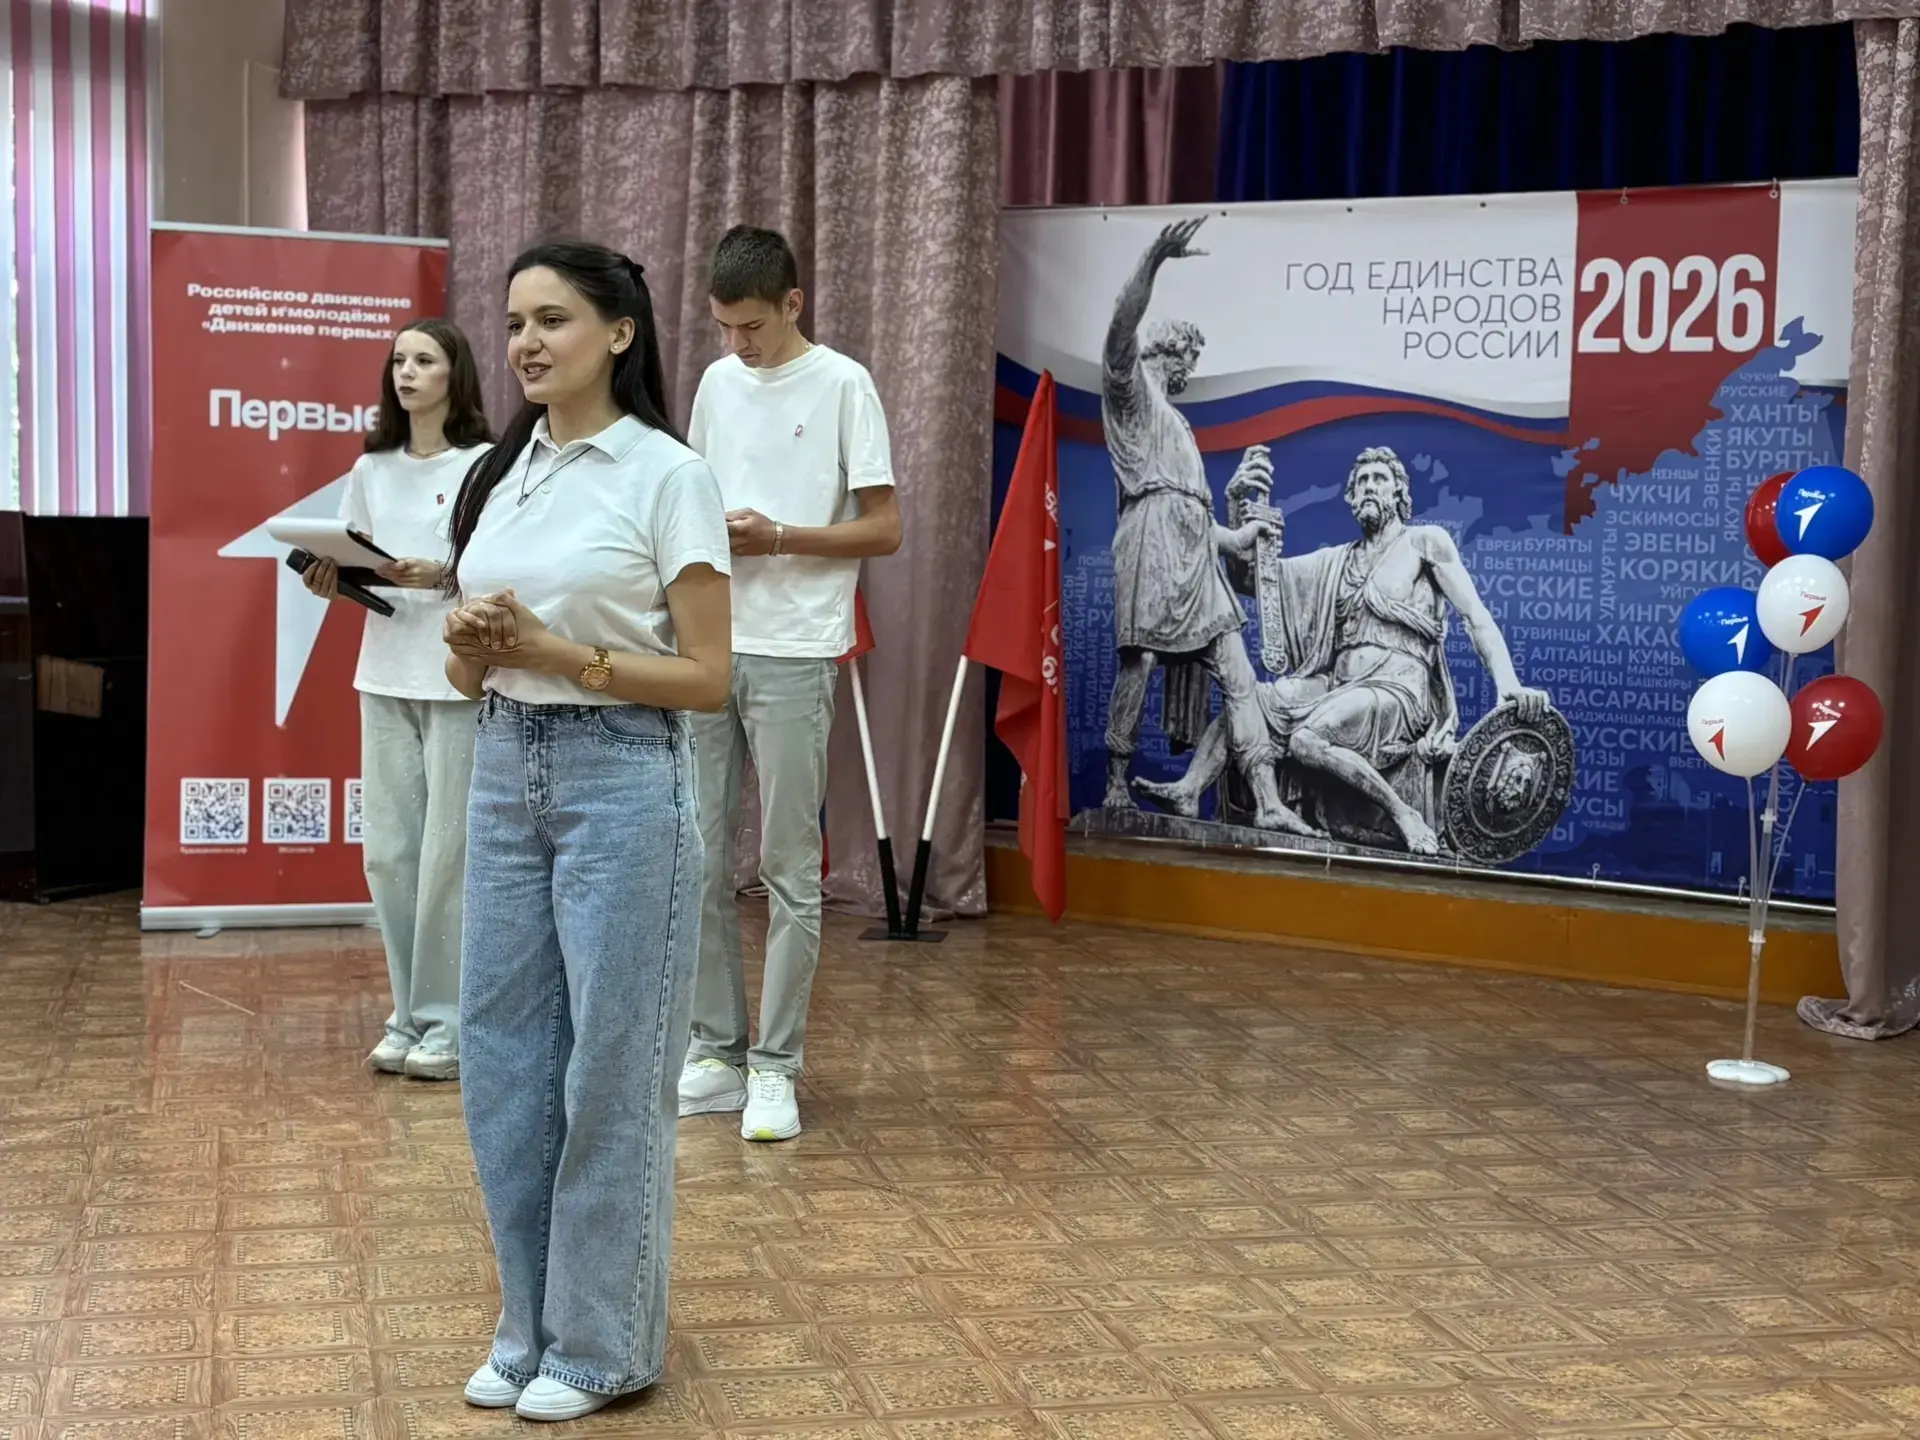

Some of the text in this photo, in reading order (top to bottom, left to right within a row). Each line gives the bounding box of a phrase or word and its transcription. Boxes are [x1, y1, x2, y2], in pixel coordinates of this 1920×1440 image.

[1286, 257, 1563, 295] ГОД ЕДИНСТВА
[187, 282, 413, 310] Российское движение
[1577, 253, 1766, 354] 2026
[208, 302, 268, 317] детей
[271, 308, 282, 318] и
[1383, 293, 1562, 329] НАРОДОВ
[201, 317, 315, 336] «Движение
[1403, 329, 1560, 360] РОССИИ
[1719, 384, 1789, 399] РУССКИЕ
[1730, 403, 1820, 424] ХАНТЫ
[1726, 426, 1814, 448] ЯКУТЫ
[1703, 428, 1723, 511] ЭВЕНКИ
[1725, 448, 1830, 471] БУРЯТЫ
[1651, 468, 1699, 481] НЕНЦЫ
[1609, 484, 1692, 506] ЧУКЧИ
[1605, 510, 1721, 528] ЭСКИМОСЫ
[1723, 475, 1743, 543] ЯКУТЫ
[1476, 538, 1521, 553] ЕВРЕИ
[1523, 537, 1593, 554] БУРЯТЫ
[1623, 532, 1717, 555] ЭВЕНЫ
[1484, 556, 1593, 575] ВЬЕТНАМЦЫ
[1600, 527, 1618, 620] УДМУРТЫ
[1619, 557, 1741, 585] КОРЯКИ
[1062, 574, 1075, 661] БЕЛОРУСЫ
[1073, 566, 1088, 661] УКРАИНЦЫ
[1520, 600, 1593, 622] КОМИ
[1510, 624, 1592, 643] ТУВИНЦЫ
[1530, 644, 1622, 667] АЛТАЙЦЫ
[1085, 628, 1099, 728] МОЛДАВАНЕ
[1531, 665, 1624, 688] КОРЕЙЦЫ
[1626, 664, 1675, 678] МАНСИ
[1626, 675, 1693, 692] БАШКИРЫ
